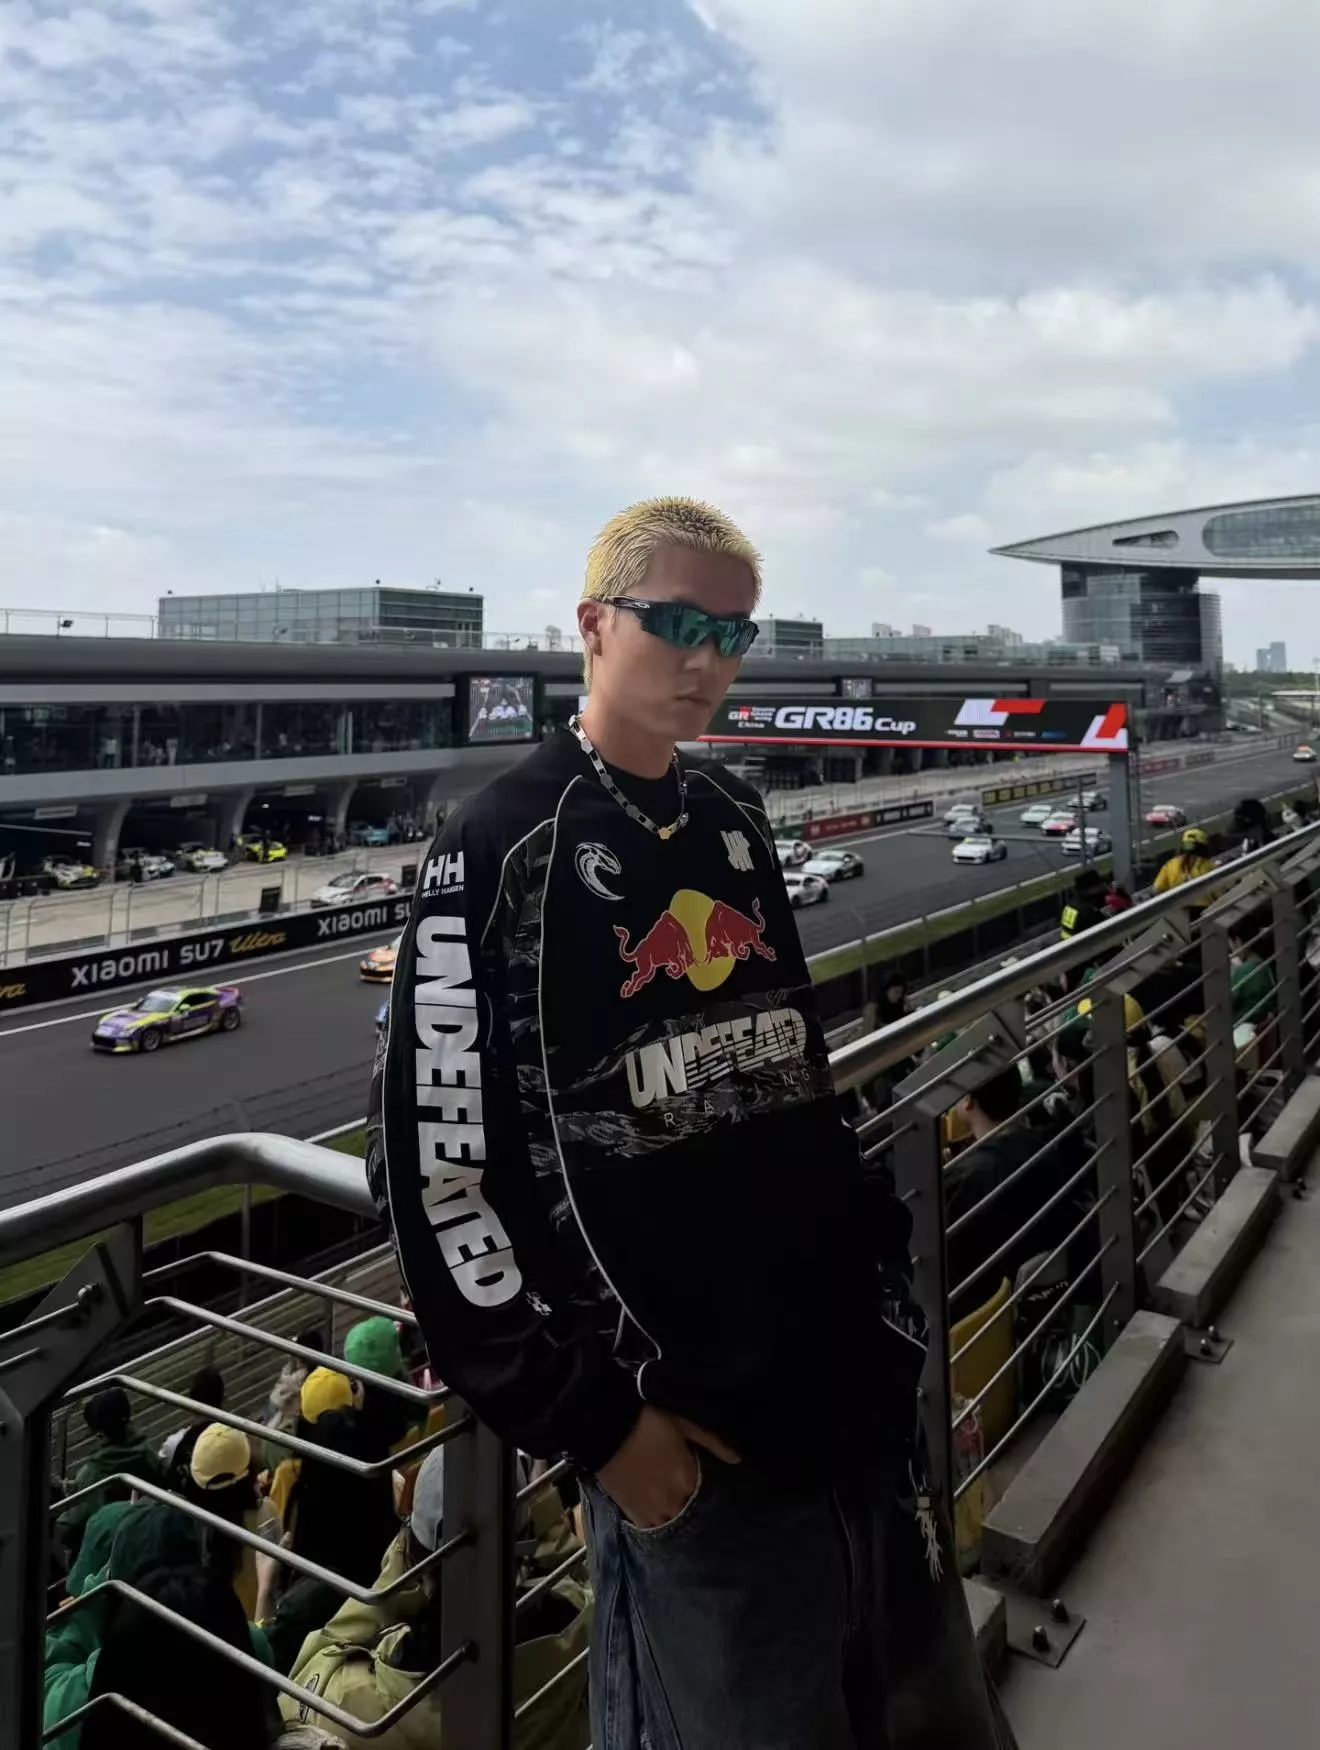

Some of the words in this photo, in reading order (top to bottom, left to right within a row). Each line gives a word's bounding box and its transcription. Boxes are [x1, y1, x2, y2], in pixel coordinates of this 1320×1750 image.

[774, 706, 874, 731] GR86
[874, 717, 916, 735] Cup
[423, 851, 464, 889] HH
[394, 903, 412, 920] SU
[180, 938, 225, 965] SU7
[229, 931, 287, 954] Ultra
[415, 916, 523, 1307] UNDEFEATED
